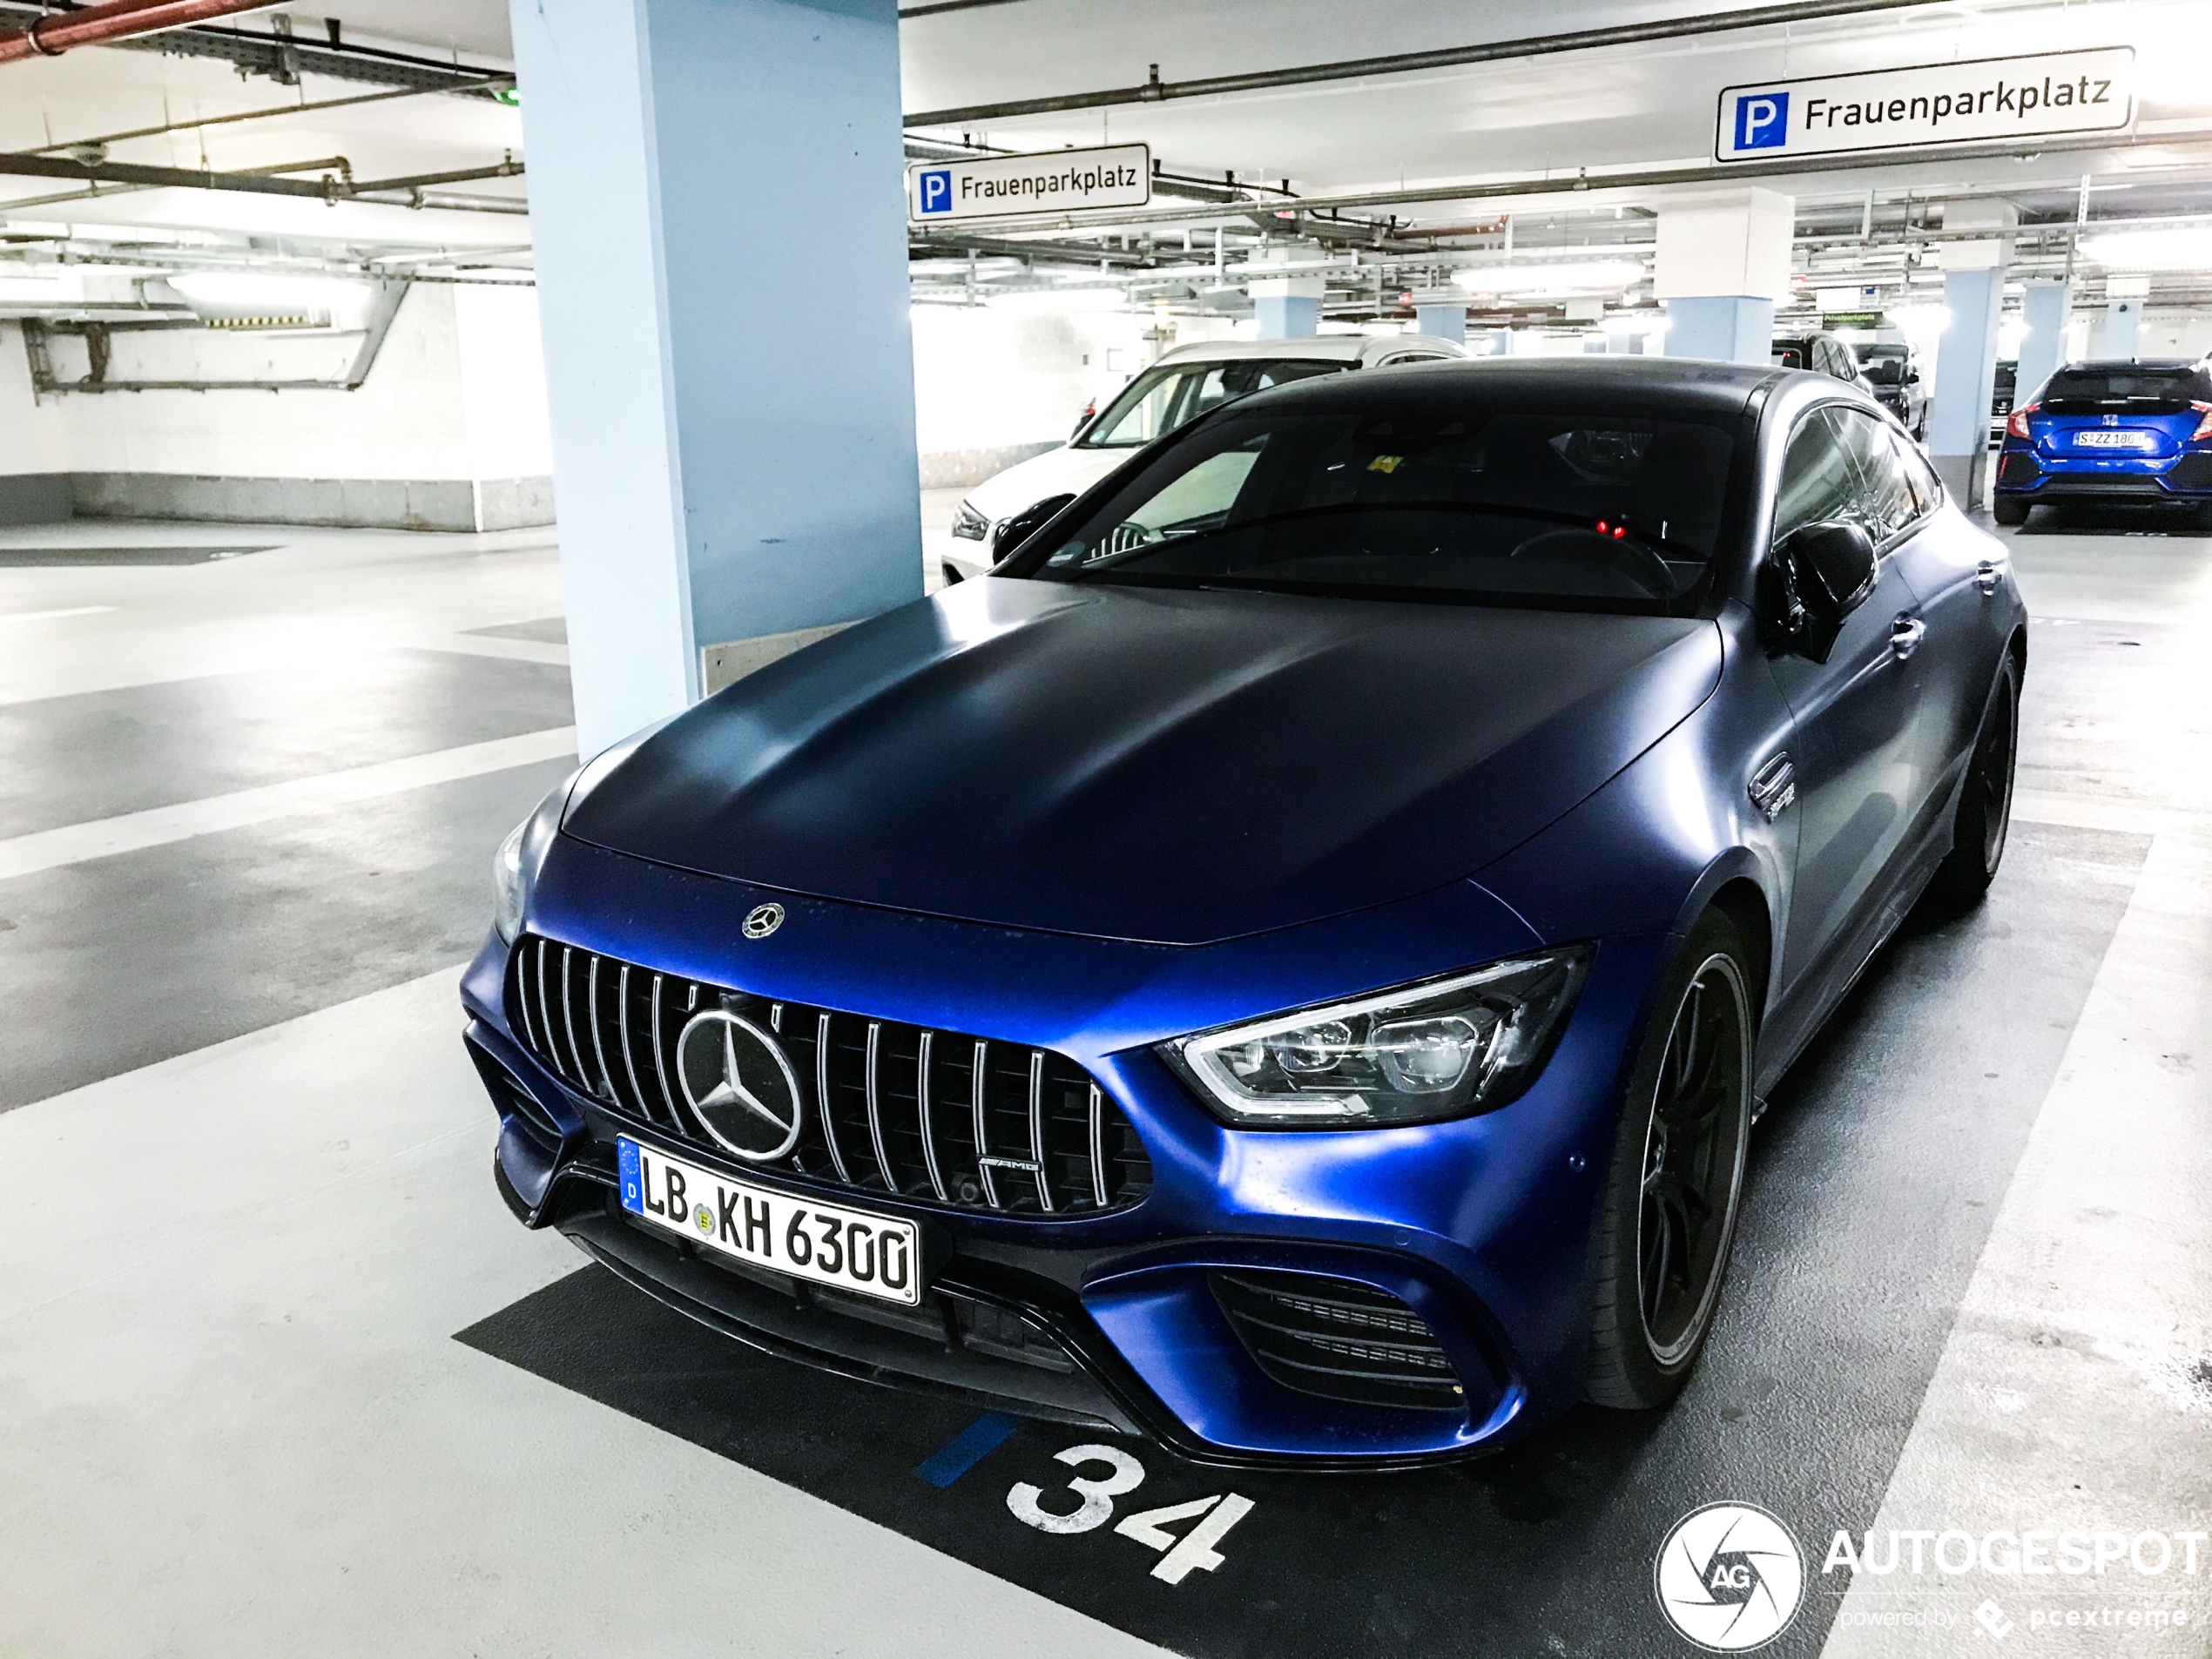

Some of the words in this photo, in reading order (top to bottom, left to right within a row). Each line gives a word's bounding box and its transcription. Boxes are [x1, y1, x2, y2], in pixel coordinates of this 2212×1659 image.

[1745, 99, 1777, 145] P
[1805, 75, 2112, 130] Frauenparkplatz
[926, 175, 945, 210] P
[961, 165, 1136, 199] Frauenparkplatz
[2080, 434, 2088, 444] S
[2095, 434, 2111, 443] ZZ
[628, 1183, 637, 1199] D
[643, 1156, 689, 1224] LB
[717, 1186, 772, 1258] KH
[786, 1209, 908, 1290] 6300
[1007, 1444, 1256, 1585] 34
